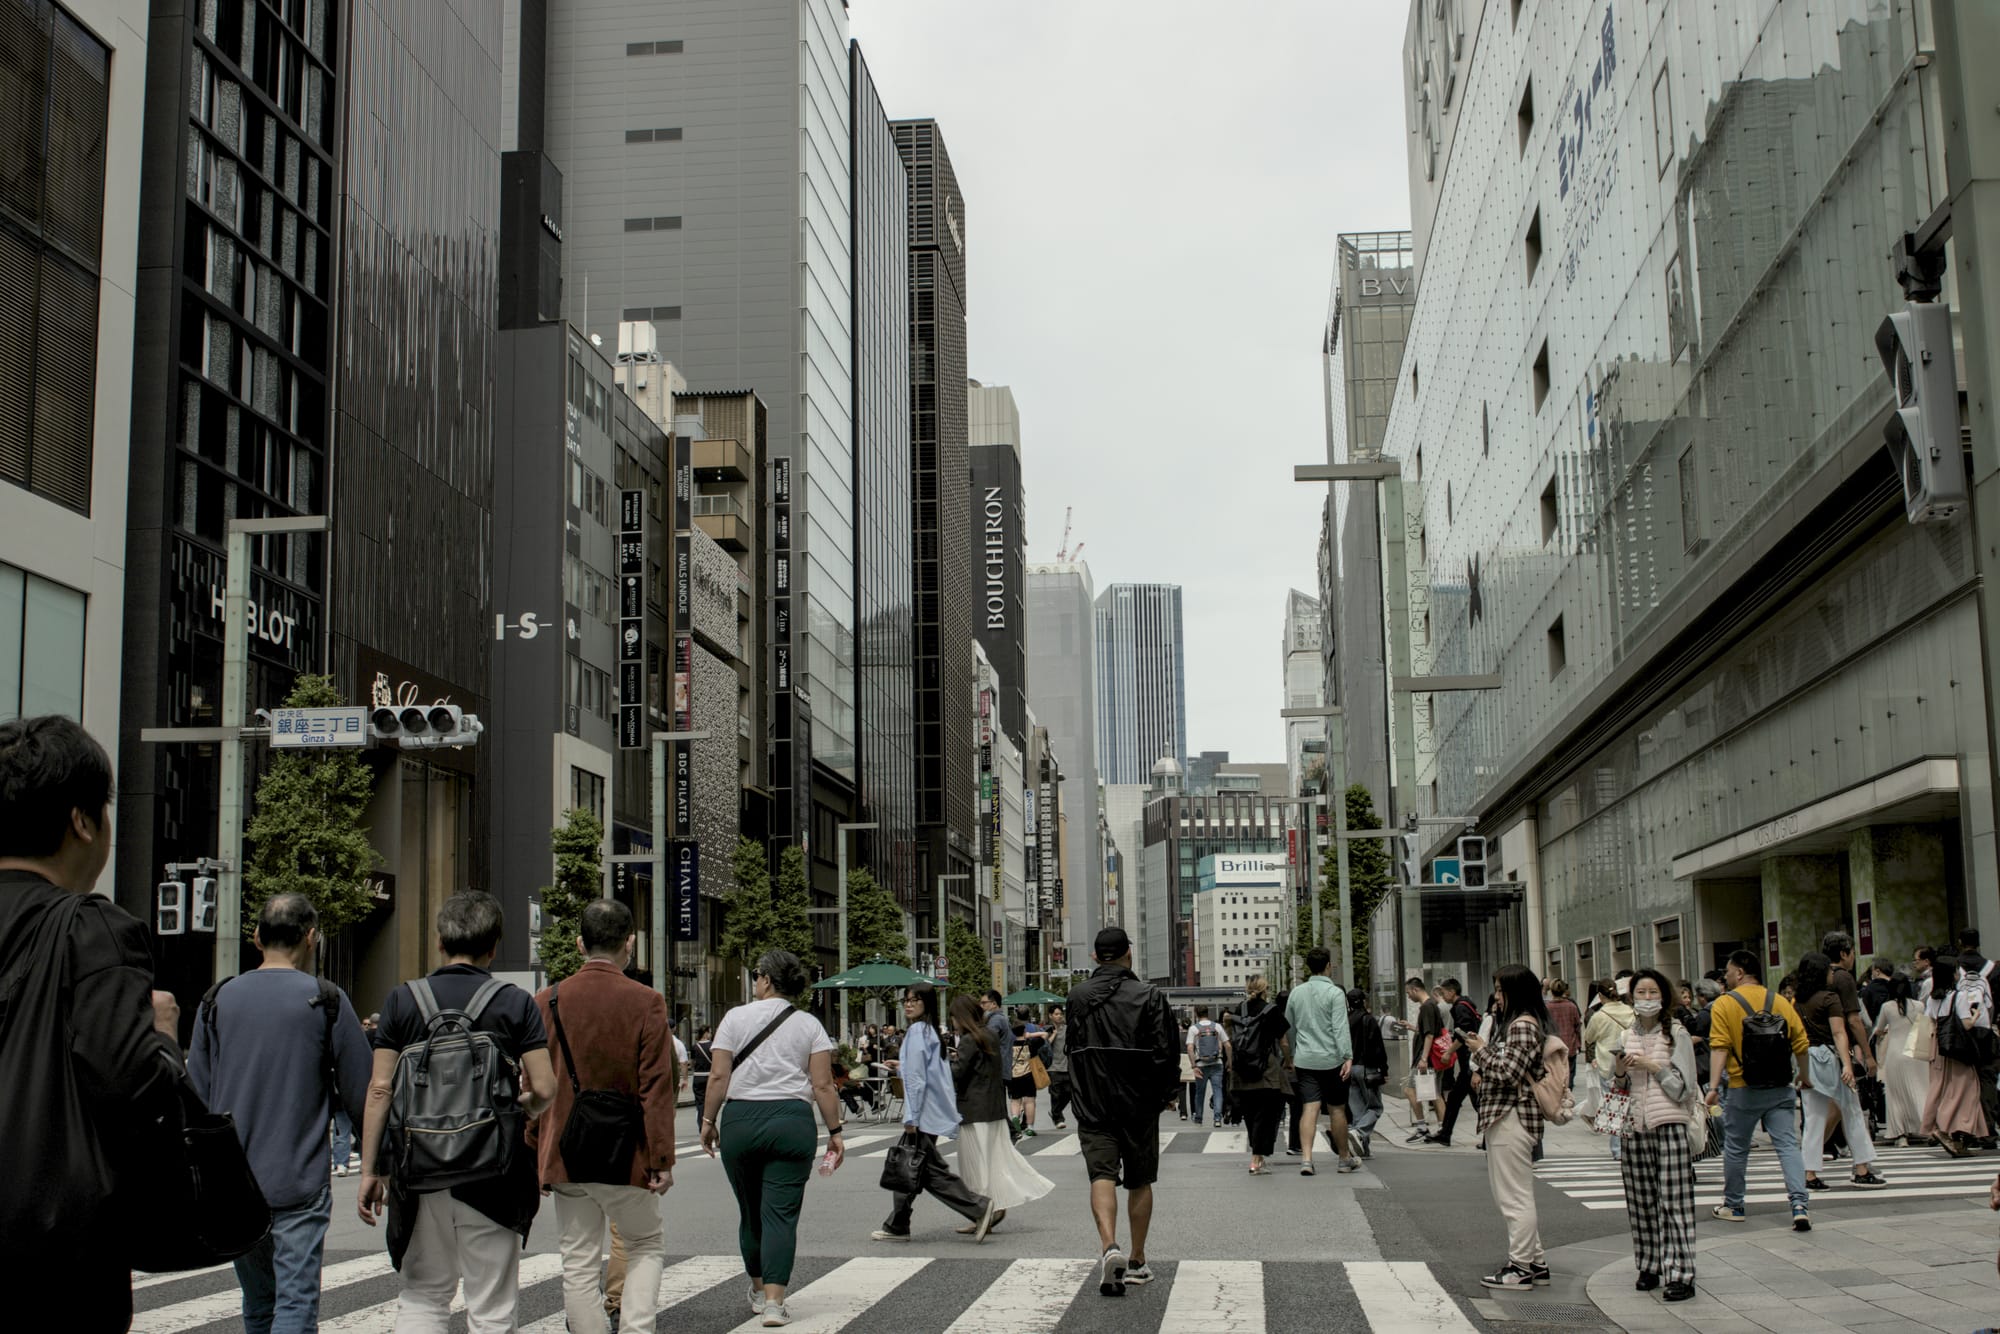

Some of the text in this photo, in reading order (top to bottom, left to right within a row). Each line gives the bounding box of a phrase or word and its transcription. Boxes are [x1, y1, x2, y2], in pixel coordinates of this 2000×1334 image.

[1558, 2, 1616, 202] ミッフィー展
[678, 553, 687, 614] NAILS UNIQUE
[986, 486, 1005, 631] BOUCHERON
[211, 584, 295, 649] HBLOT
[779, 610, 788, 632] Zina
[277, 717, 359, 734] 銀座三丁目
[278, 710, 303, 718] 中央区
[301, 734, 335, 743] Ginza 3
[678, 752, 687, 823] BDC PILATES
[680, 847, 691, 936] CHAUMET
[1221, 860, 1275, 871] Brilli
